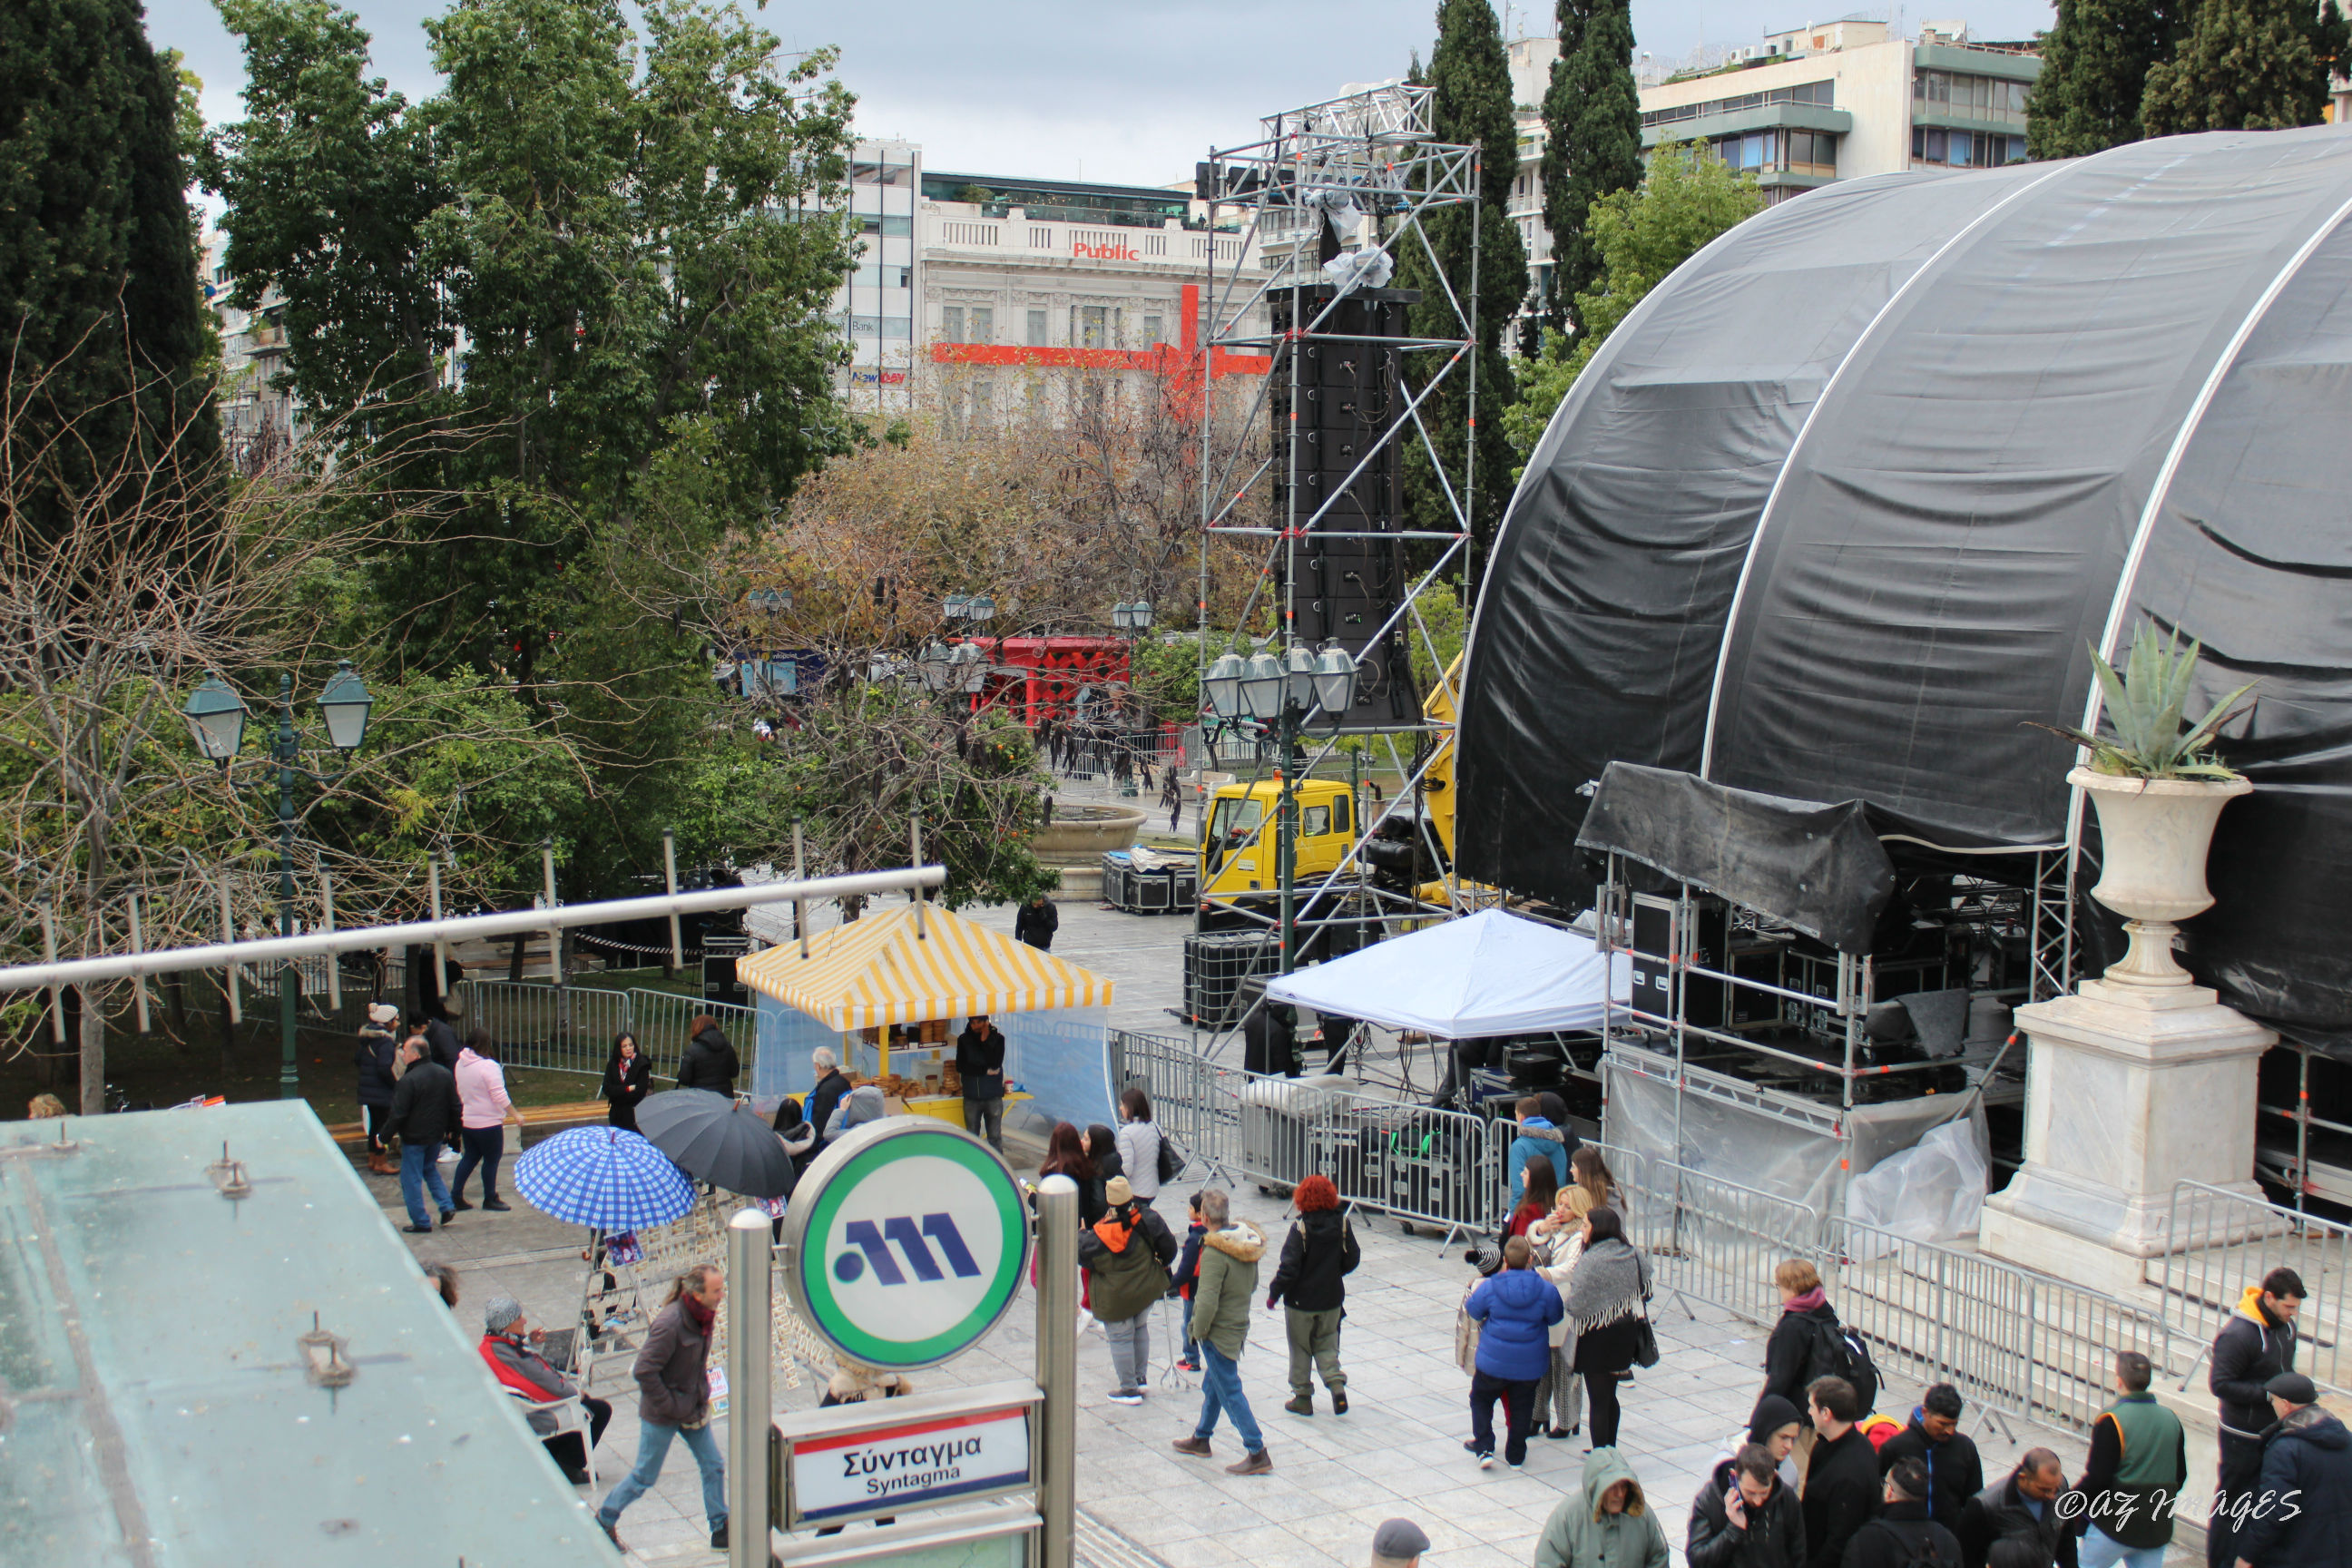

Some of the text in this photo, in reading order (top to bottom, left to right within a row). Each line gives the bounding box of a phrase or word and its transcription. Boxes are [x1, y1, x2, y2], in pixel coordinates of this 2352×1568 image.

[1073, 242, 1140, 261] Public
[852, 320, 874, 331] Bank
[852, 371, 878, 383] New
[844, 1436, 982, 1477] Σύνταγμα
[867, 1466, 961, 1496] Syntagma
